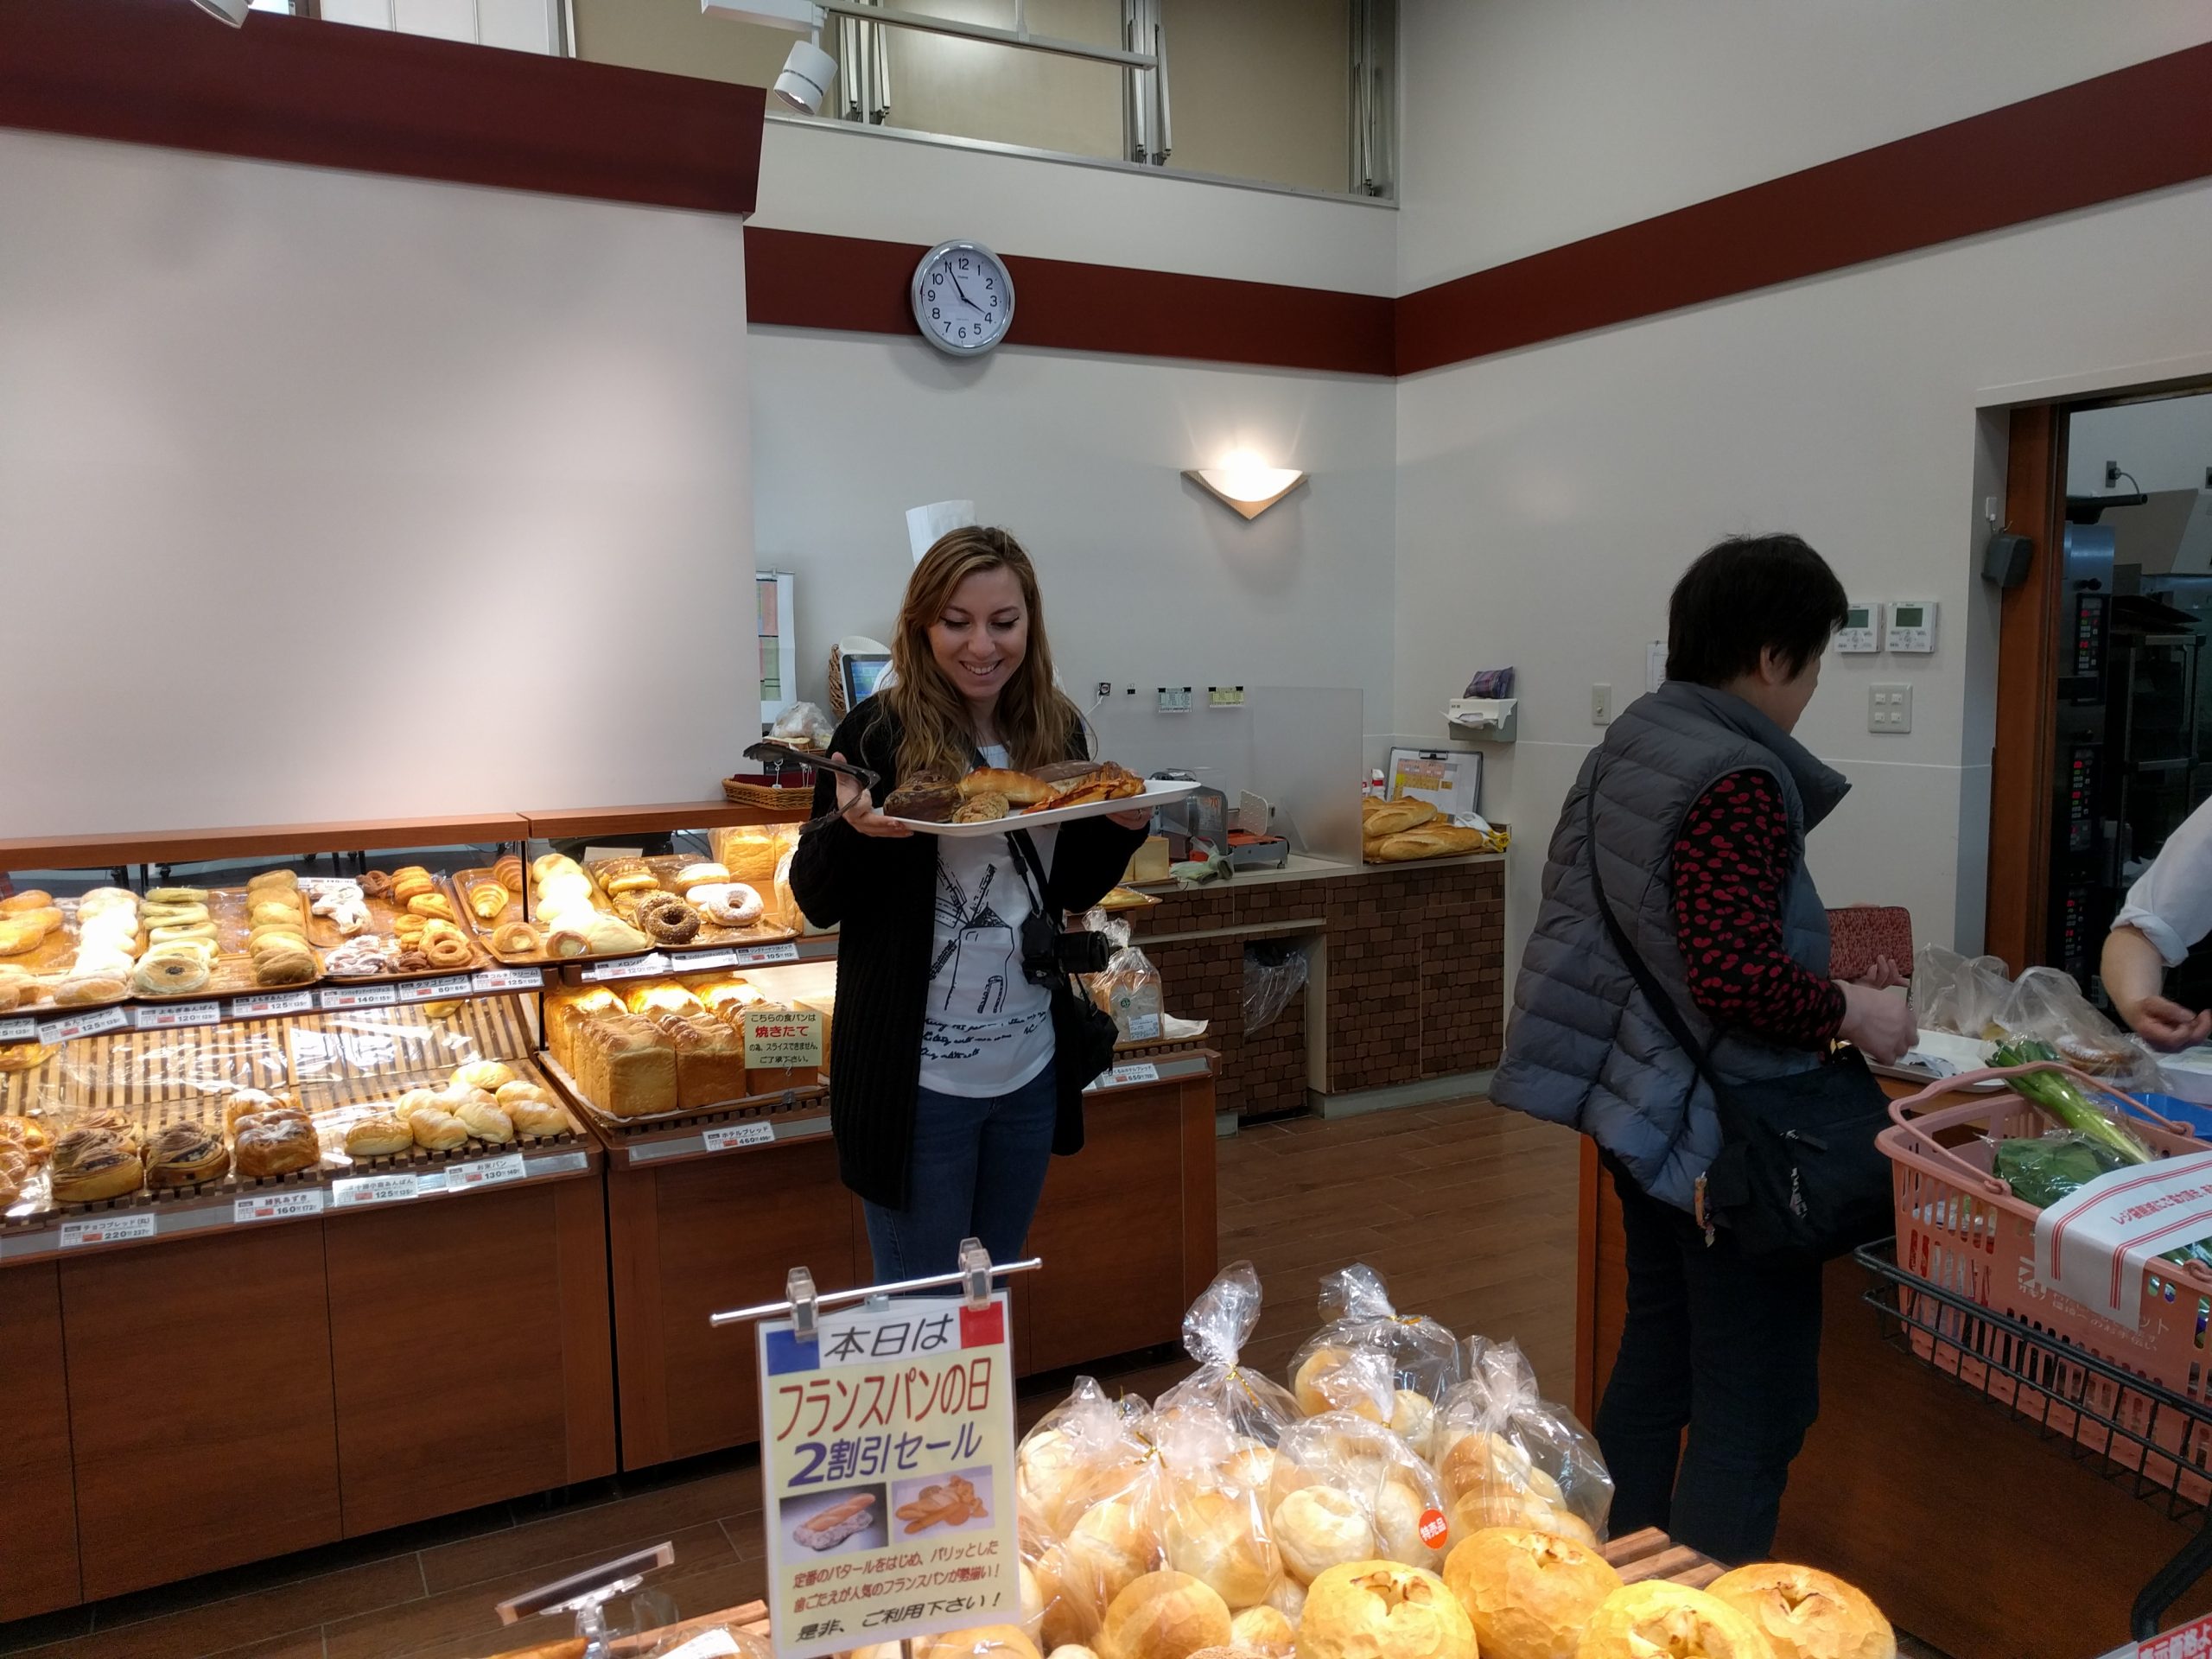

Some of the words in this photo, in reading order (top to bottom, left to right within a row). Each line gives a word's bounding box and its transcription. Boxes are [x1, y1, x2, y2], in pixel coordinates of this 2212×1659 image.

[958, 257, 969, 270] 12
[932, 273, 944, 285] 10
[985, 278, 994, 290] 2
[927, 289, 936, 302] 9
[989, 295, 998, 308] 3
[931, 308, 940, 320] 8
[984, 312, 993, 324] 4
[944, 321, 951, 334] 7
[958, 327, 967, 339] 6
[974, 323, 982, 335] 5
[751, 1014, 817, 1022] こちらの食パンは
[82, 1021, 100, 1032] 125
[755, 1025, 810, 1039] 焼きたて
[485, 1171, 502, 1179] 130
[376, 1190, 394, 1198] 125
[276, 1205, 296, 1215] 160
[105, 1230, 127, 1240] 220
[824, 1313, 954, 1362] 本日は
[777, 1357, 992, 1441] フランスパンの日
[787, 1421, 982, 1488] 2割引セール
[1420, 1517, 1446, 1541] 特売品
[795, 1592, 1001, 1643] 是非、ご利用下さい！
